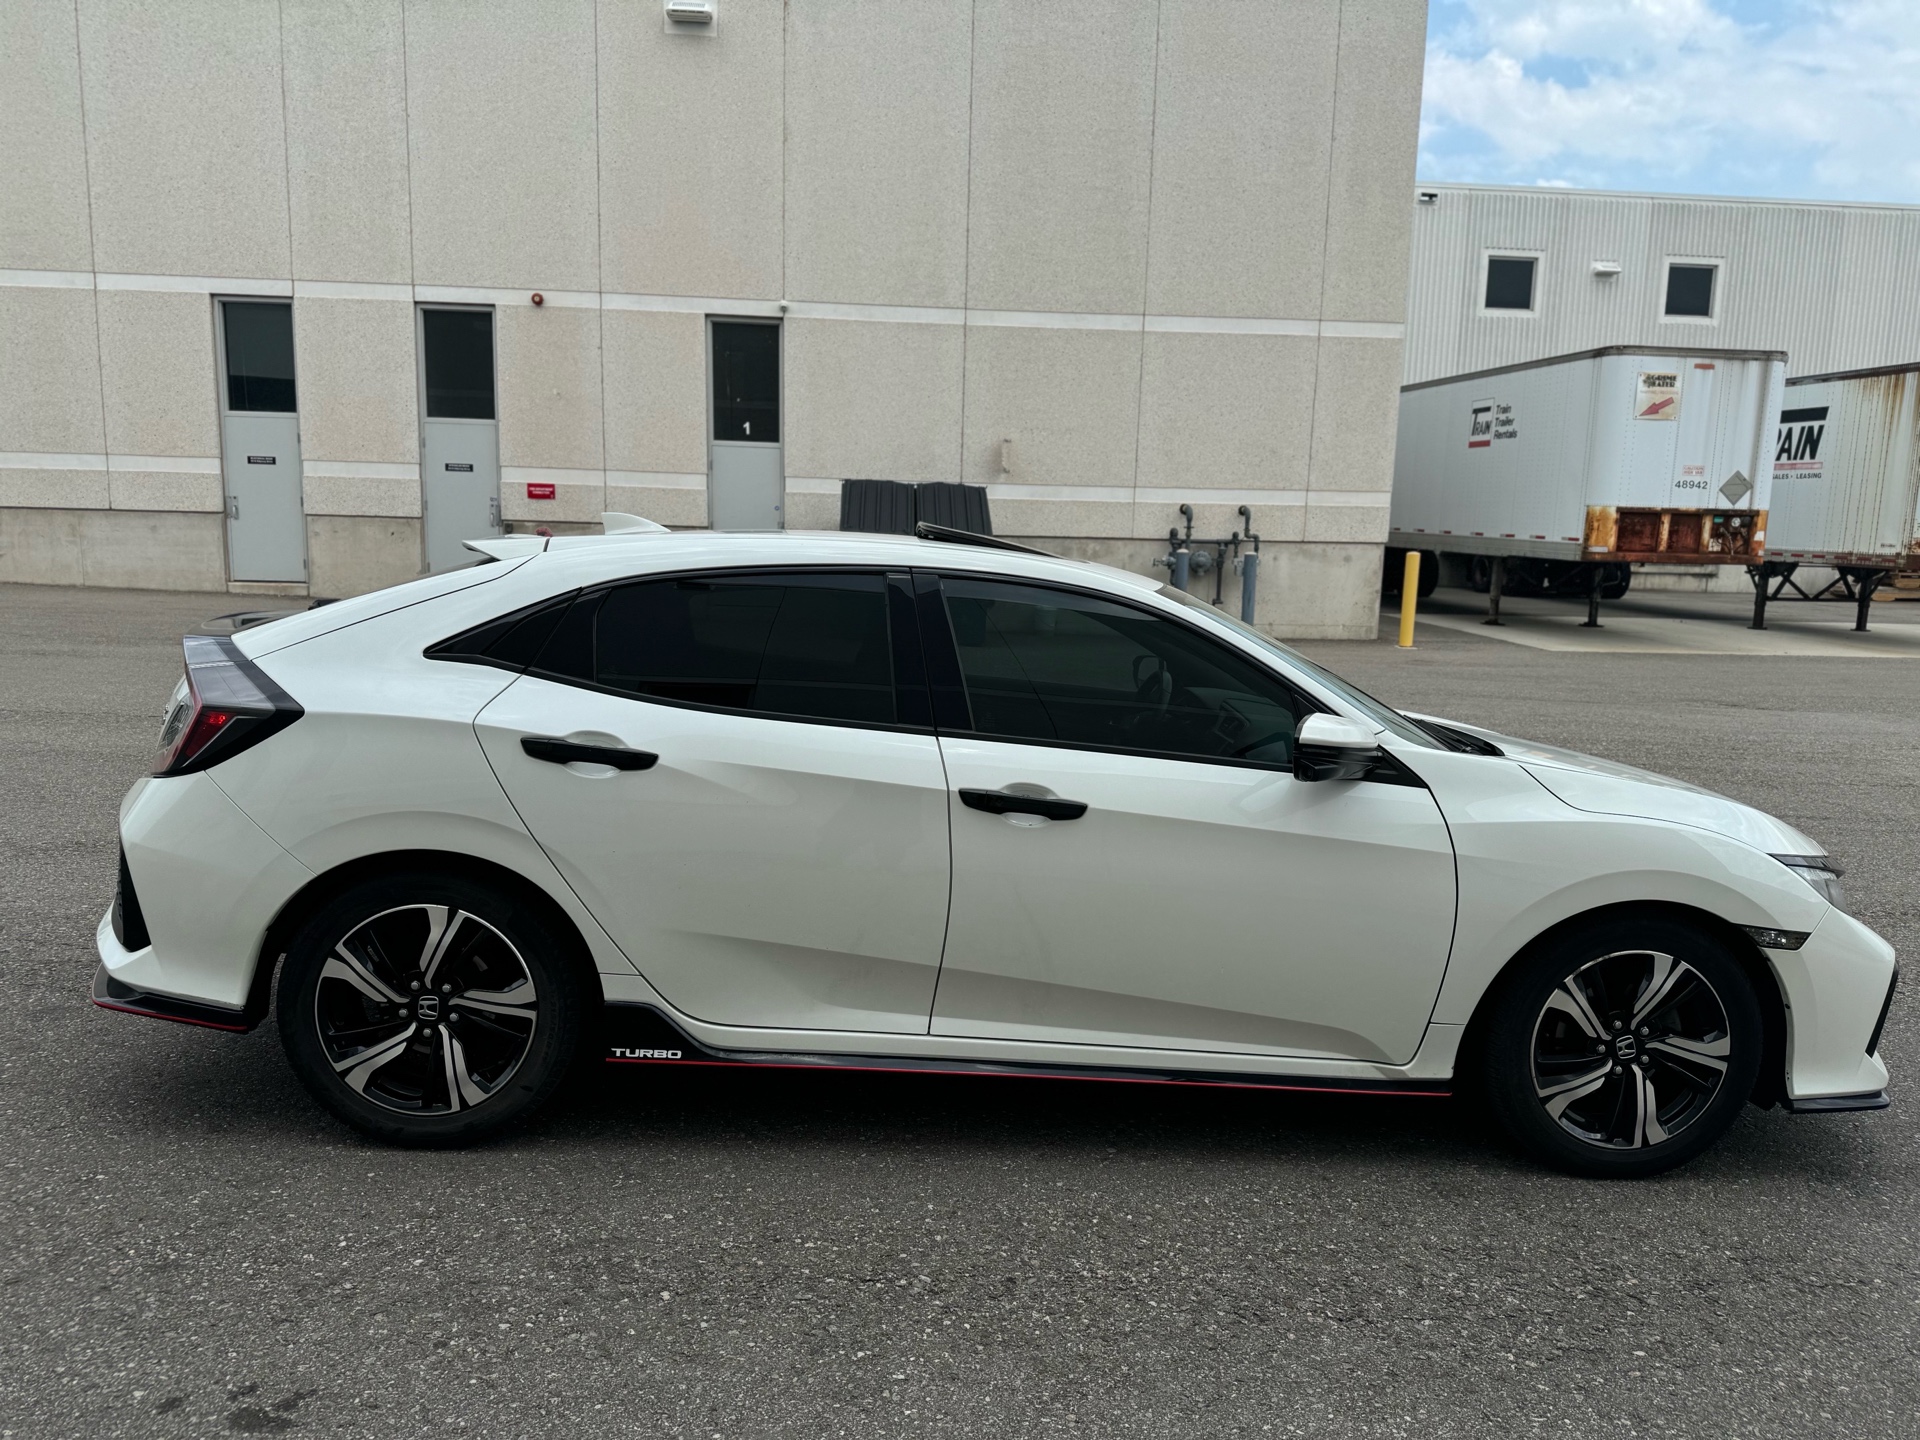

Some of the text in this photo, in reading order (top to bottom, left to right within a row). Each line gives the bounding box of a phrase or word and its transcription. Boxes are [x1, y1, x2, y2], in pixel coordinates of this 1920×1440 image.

[1496, 404, 1512, 415] Train
[1471, 406, 1492, 436] TRAIN
[1494, 416, 1515, 428] Trailer
[743, 421, 750, 435] 1
[1493, 428, 1518, 440] Rentals
[1796, 472, 1822, 480] LEASING
[1674, 479, 1708, 490] 48942
[610, 1047, 682, 1059] TURBO
